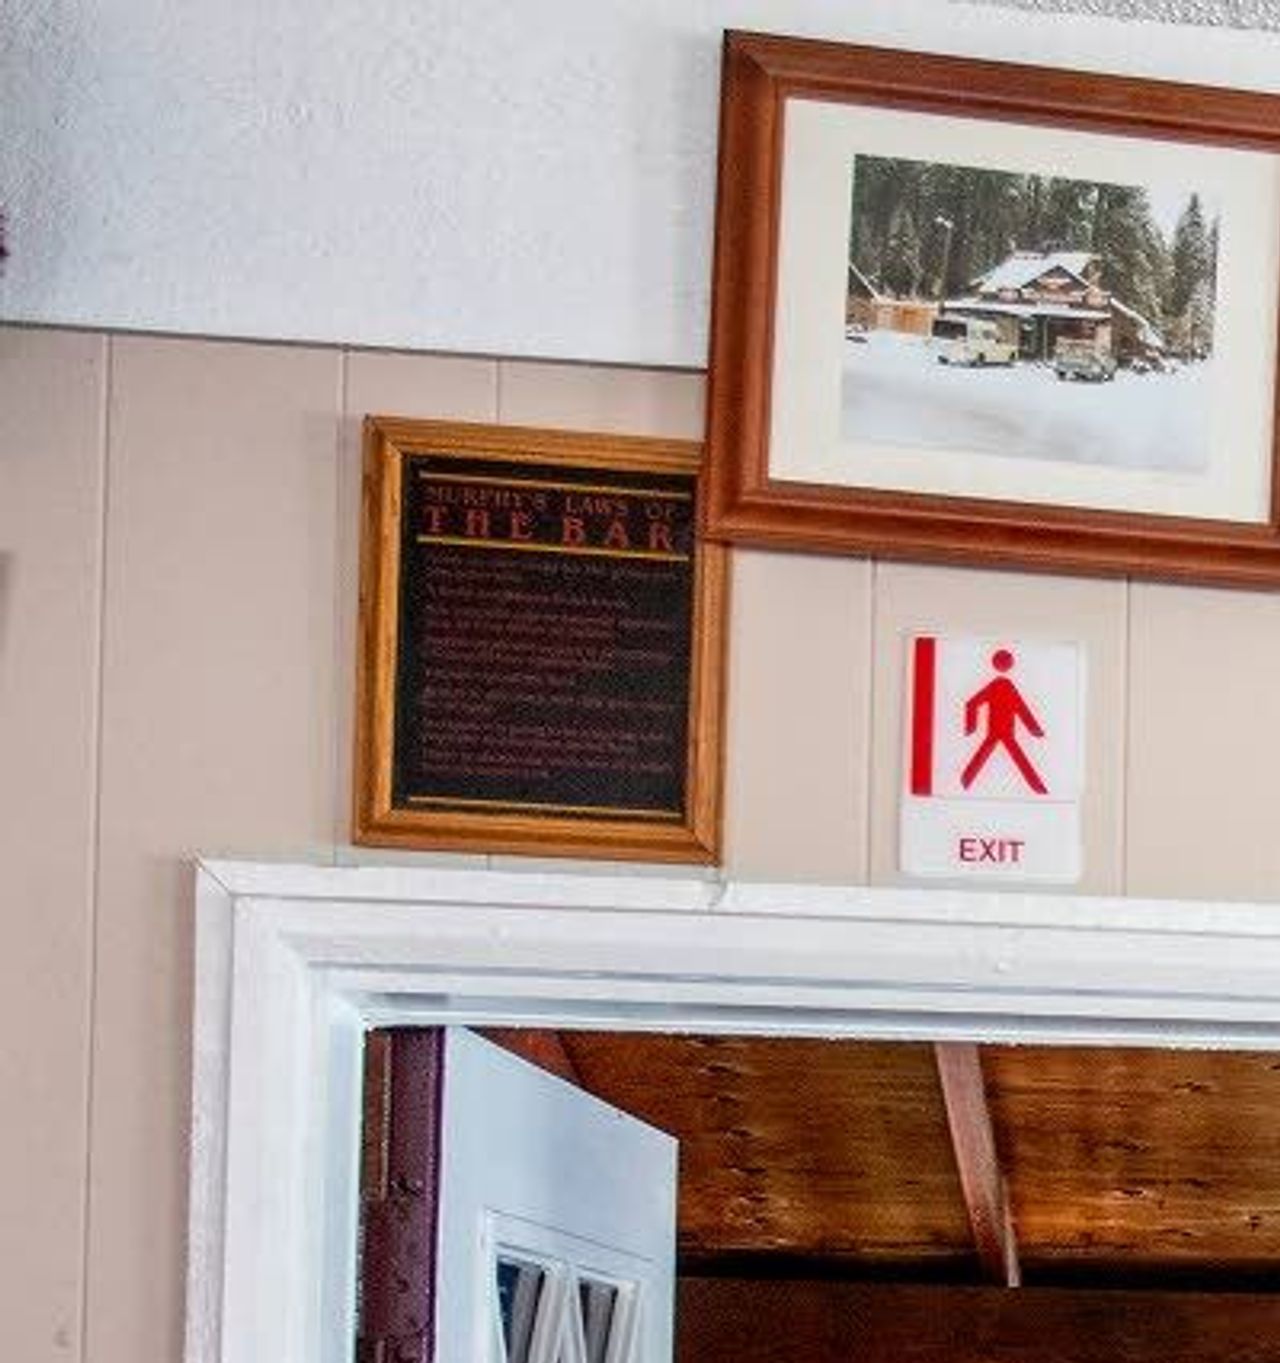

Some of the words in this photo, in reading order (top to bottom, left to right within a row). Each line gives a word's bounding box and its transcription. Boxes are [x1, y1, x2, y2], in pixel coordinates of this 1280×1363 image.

[565, 495, 630, 516] LAWS
[644, 501, 678, 520] OF
[422, 505, 535, 540] THE
[562, 517, 673, 551] BAR
[958, 837, 1025, 863] EXIT
